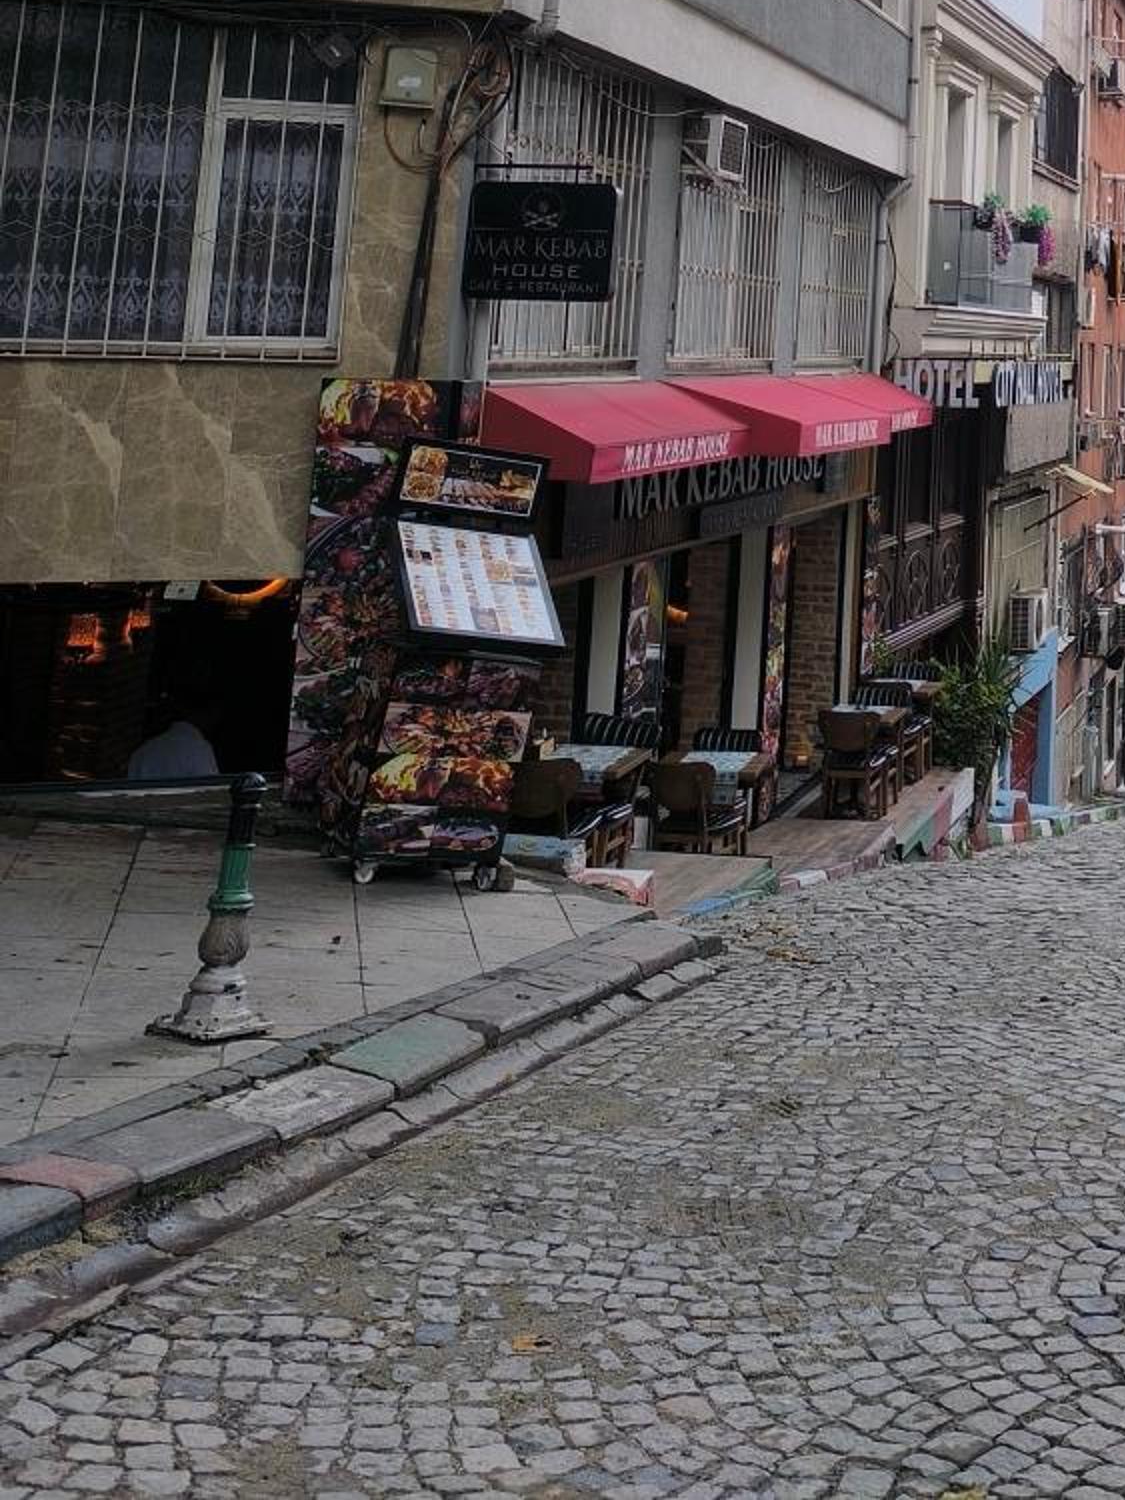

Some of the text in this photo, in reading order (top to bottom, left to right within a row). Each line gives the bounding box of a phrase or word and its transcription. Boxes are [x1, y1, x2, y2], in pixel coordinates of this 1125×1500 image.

[473, 234, 606, 261] MAR KEBAB
[493, 263, 581, 279] HOUSE
[893, 359, 979, 408] HOTEL
[620, 473, 681, 520] MAR
[686, 457, 760, 506] KEBAB
[765, 455, 823, 487] HOUSE
